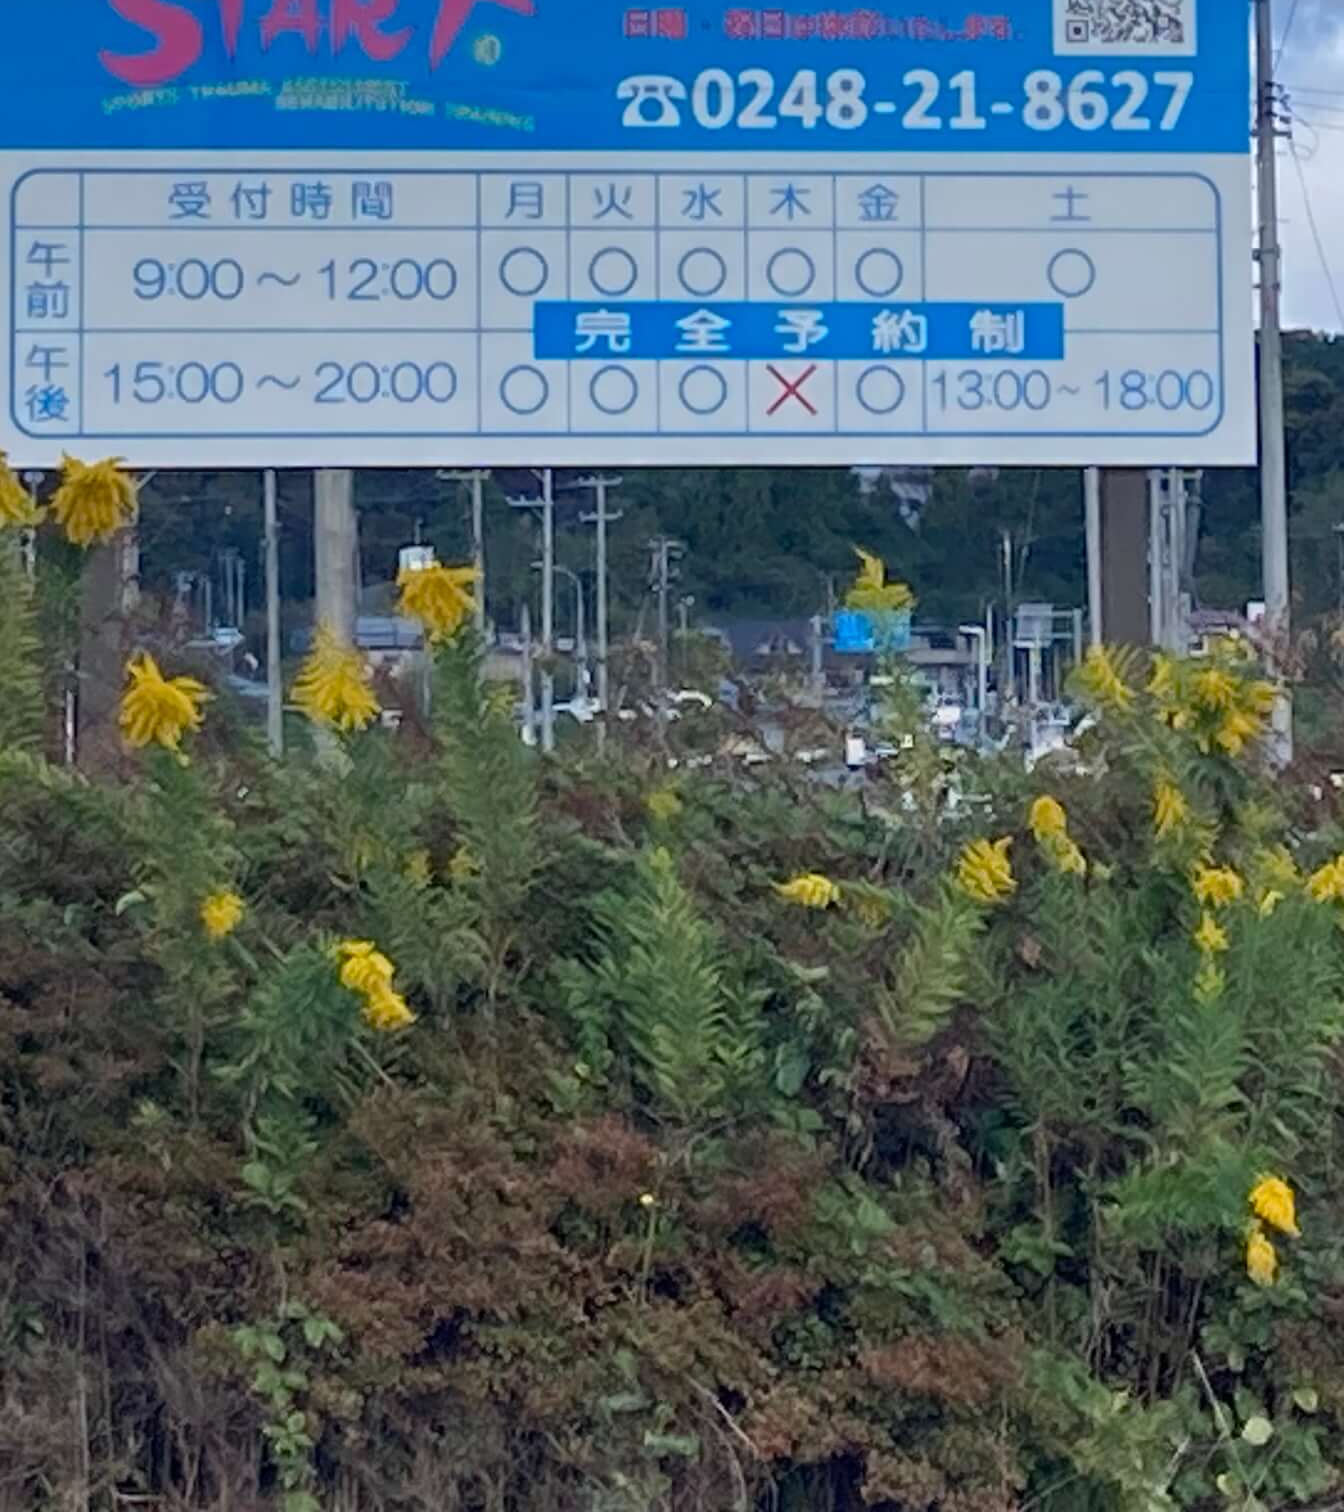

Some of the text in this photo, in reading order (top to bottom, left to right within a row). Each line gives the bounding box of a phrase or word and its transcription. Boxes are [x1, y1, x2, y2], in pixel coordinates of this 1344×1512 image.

[692, 68, 1194, 130] 0248-21-8627
[167, 181, 1091, 222] 受付時間 月 火 水 木 金 土
[25, 240, 71, 320] 午前
[574, 309, 1025, 354] 完全予約制
[25, 343, 71, 423] 午後
